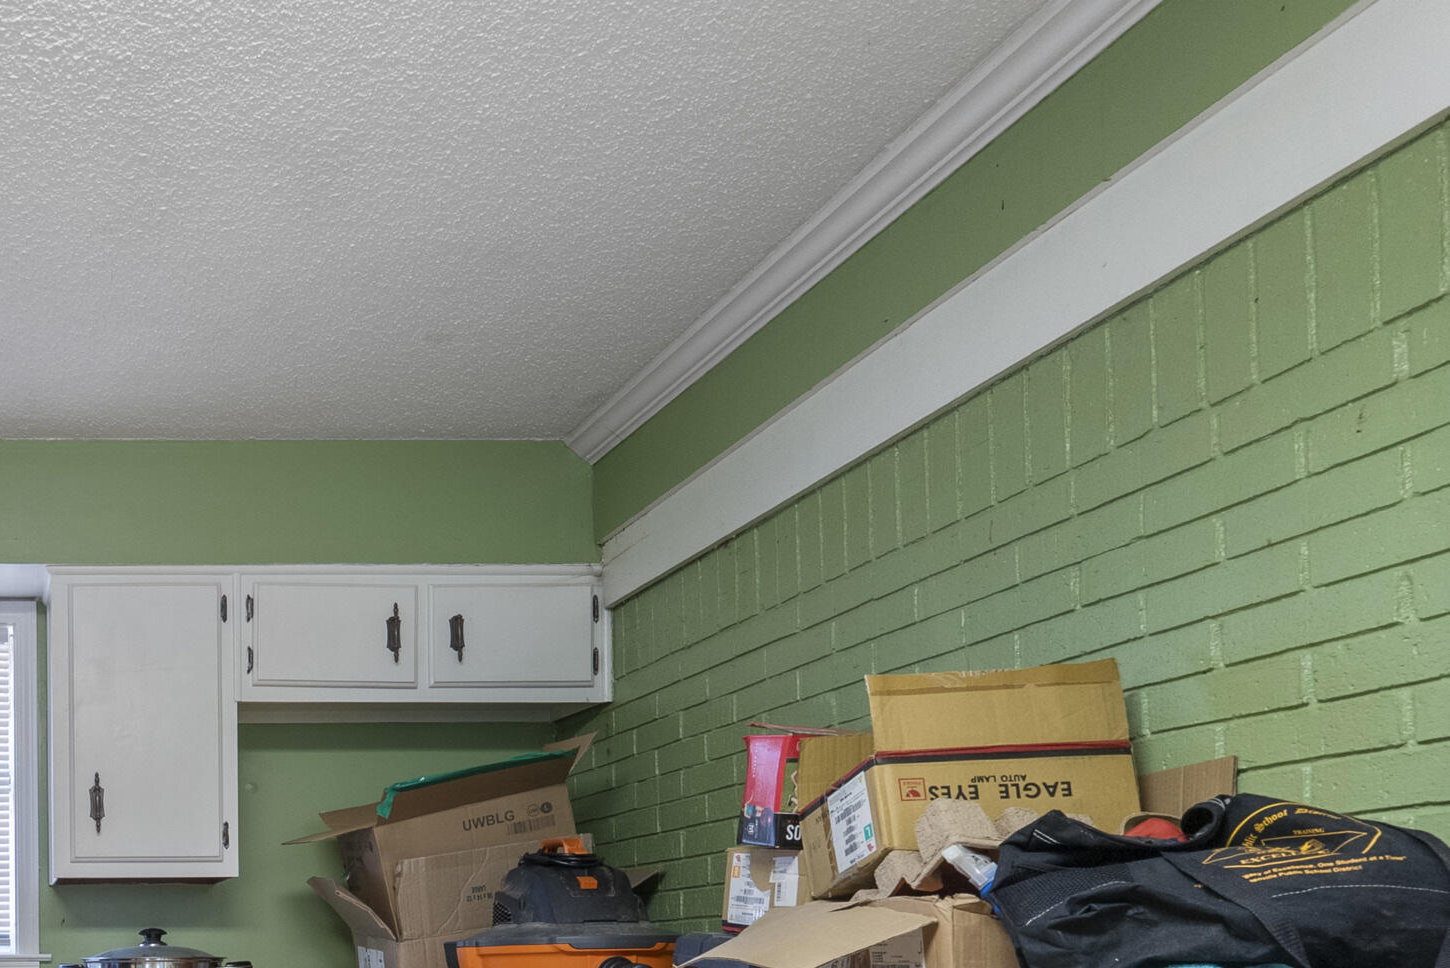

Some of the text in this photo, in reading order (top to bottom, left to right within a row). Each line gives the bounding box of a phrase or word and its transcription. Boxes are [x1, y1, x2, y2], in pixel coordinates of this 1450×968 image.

[970, 774, 1027, 783] AUTO LAMP
[928, 782, 1072, 800] EAGLE EYES
[462, 810, 515, 831] UWBLG
